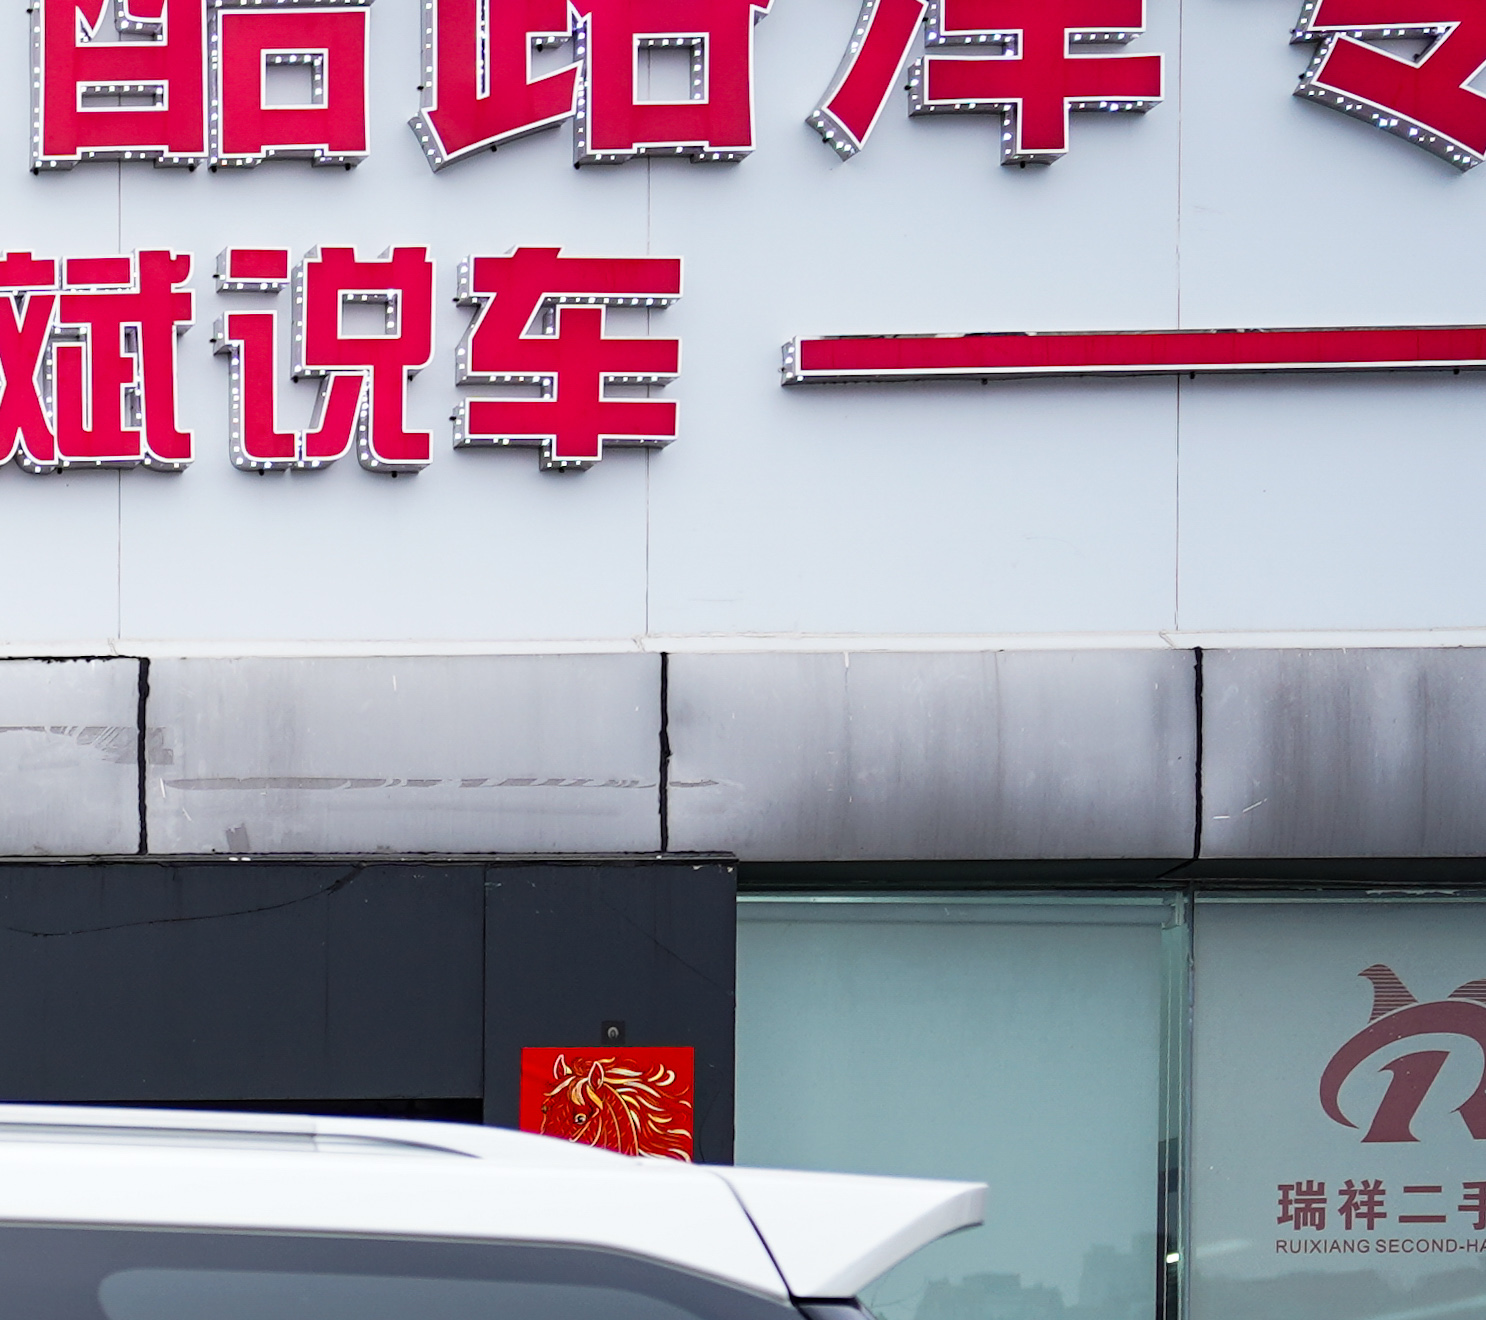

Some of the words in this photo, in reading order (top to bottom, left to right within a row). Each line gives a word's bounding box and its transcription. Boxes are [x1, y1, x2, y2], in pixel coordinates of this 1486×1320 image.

[1277, 1179, 1486, 1230] 瑞祥二手
[1276, 1239, 1370, 1253] RUIXIANG
